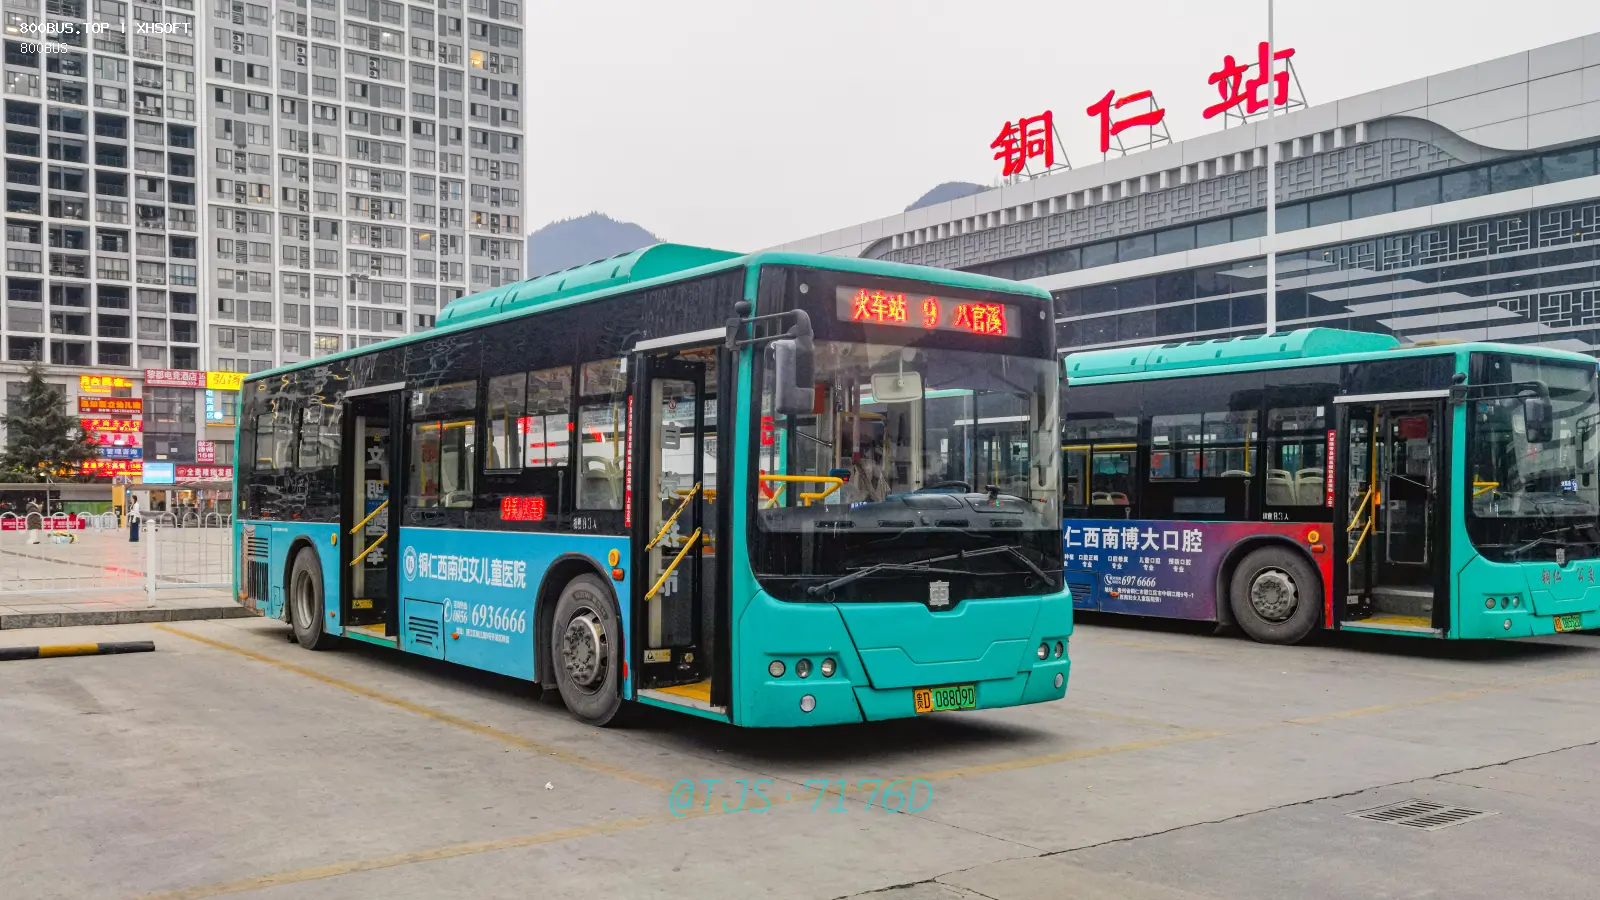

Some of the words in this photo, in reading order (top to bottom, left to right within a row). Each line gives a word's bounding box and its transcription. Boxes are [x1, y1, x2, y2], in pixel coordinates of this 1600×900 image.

[990, 41, 1296, 177] 铜仁站
[853, 288, 908, 322] 火车站
[922, 297, 938, 328] 9
[954, 302, 1006, 335] 八官溪
[1064, 525, 1203, 552] 仁西南博大口腔
[418, 552, 527, 589] 铜仁西南妇女儿童医院
[1121, 575, 1137, 586] 697
[1137, 576, 1156, 588] 6666
[453, 609, 467, 624] 0856
[471, 603, 527, 634] 6936666
[916, 690, 932, 710] 贵D
[934, 687, 975, 708] 08809D
